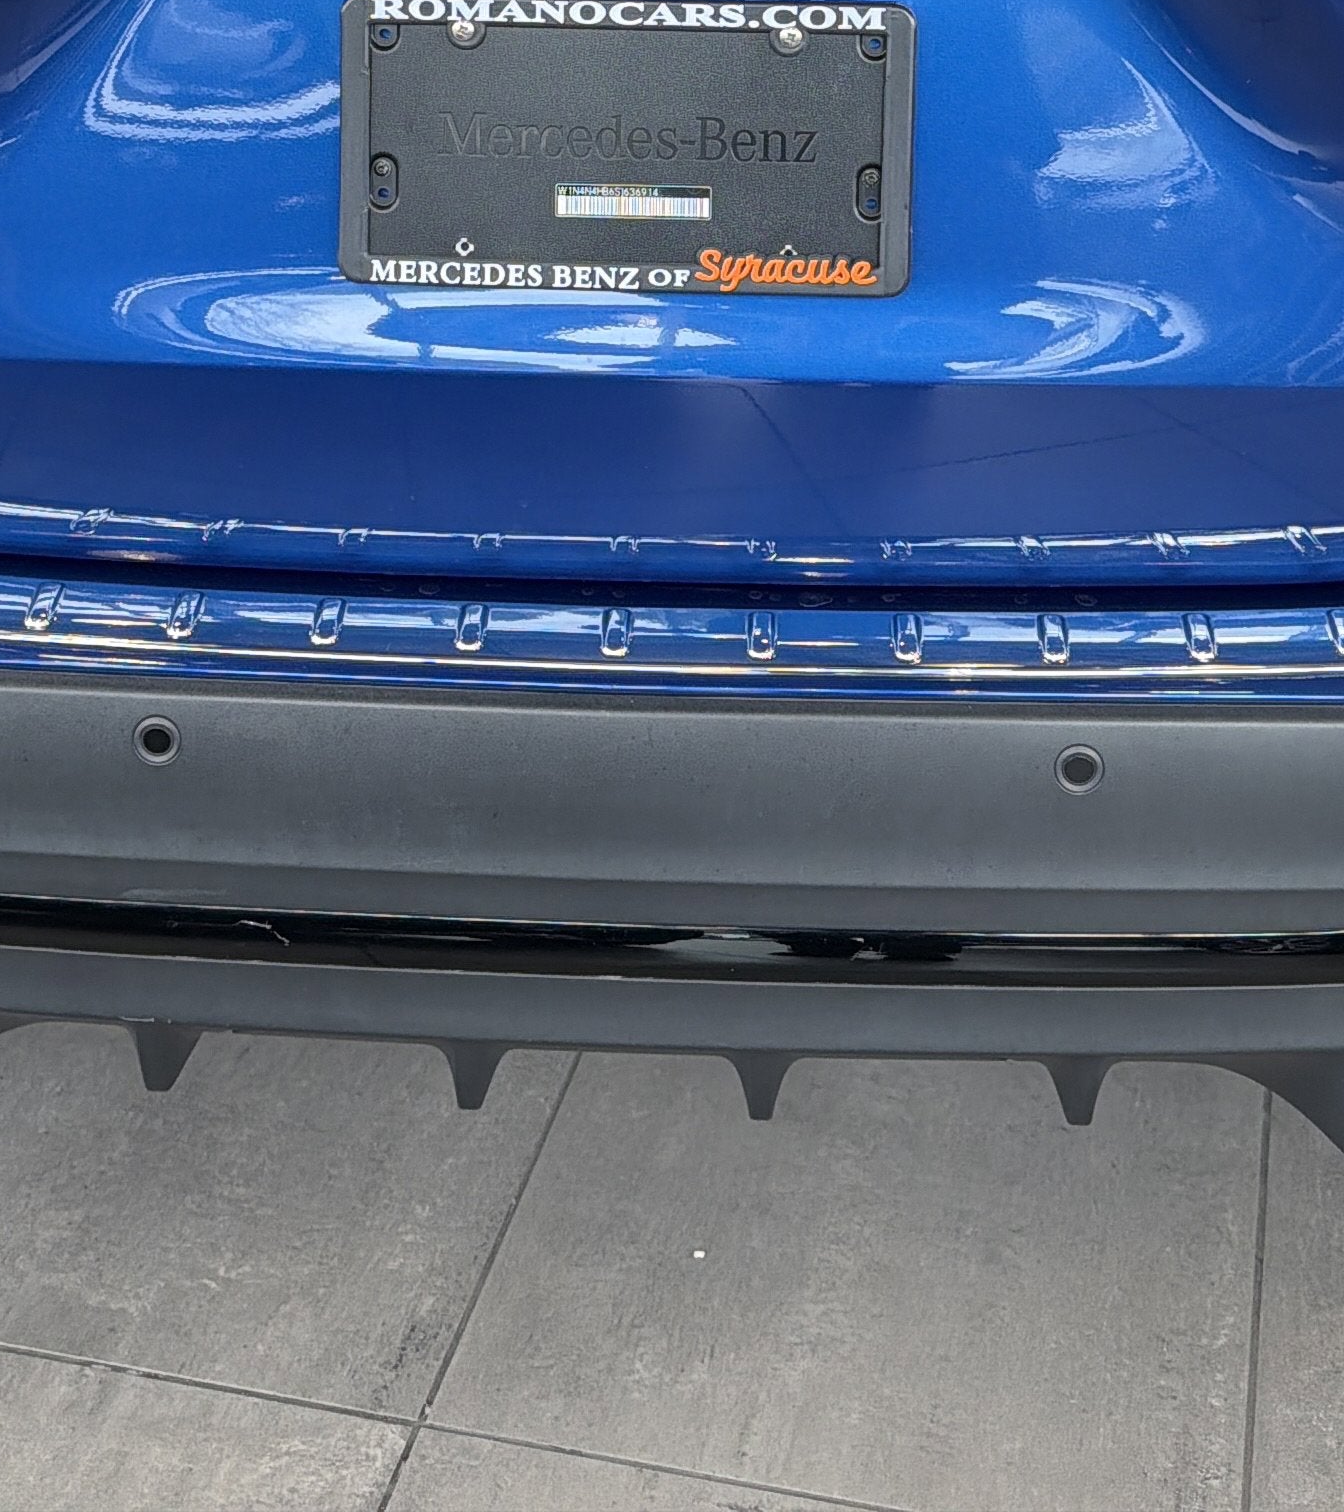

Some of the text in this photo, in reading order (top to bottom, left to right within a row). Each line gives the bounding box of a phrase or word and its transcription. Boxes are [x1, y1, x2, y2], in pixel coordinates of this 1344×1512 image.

[437, 110, 819, 164] Mercedes-Benz
[369, 248, 878, 293] MERCEDES BENZ OF Syracuse
